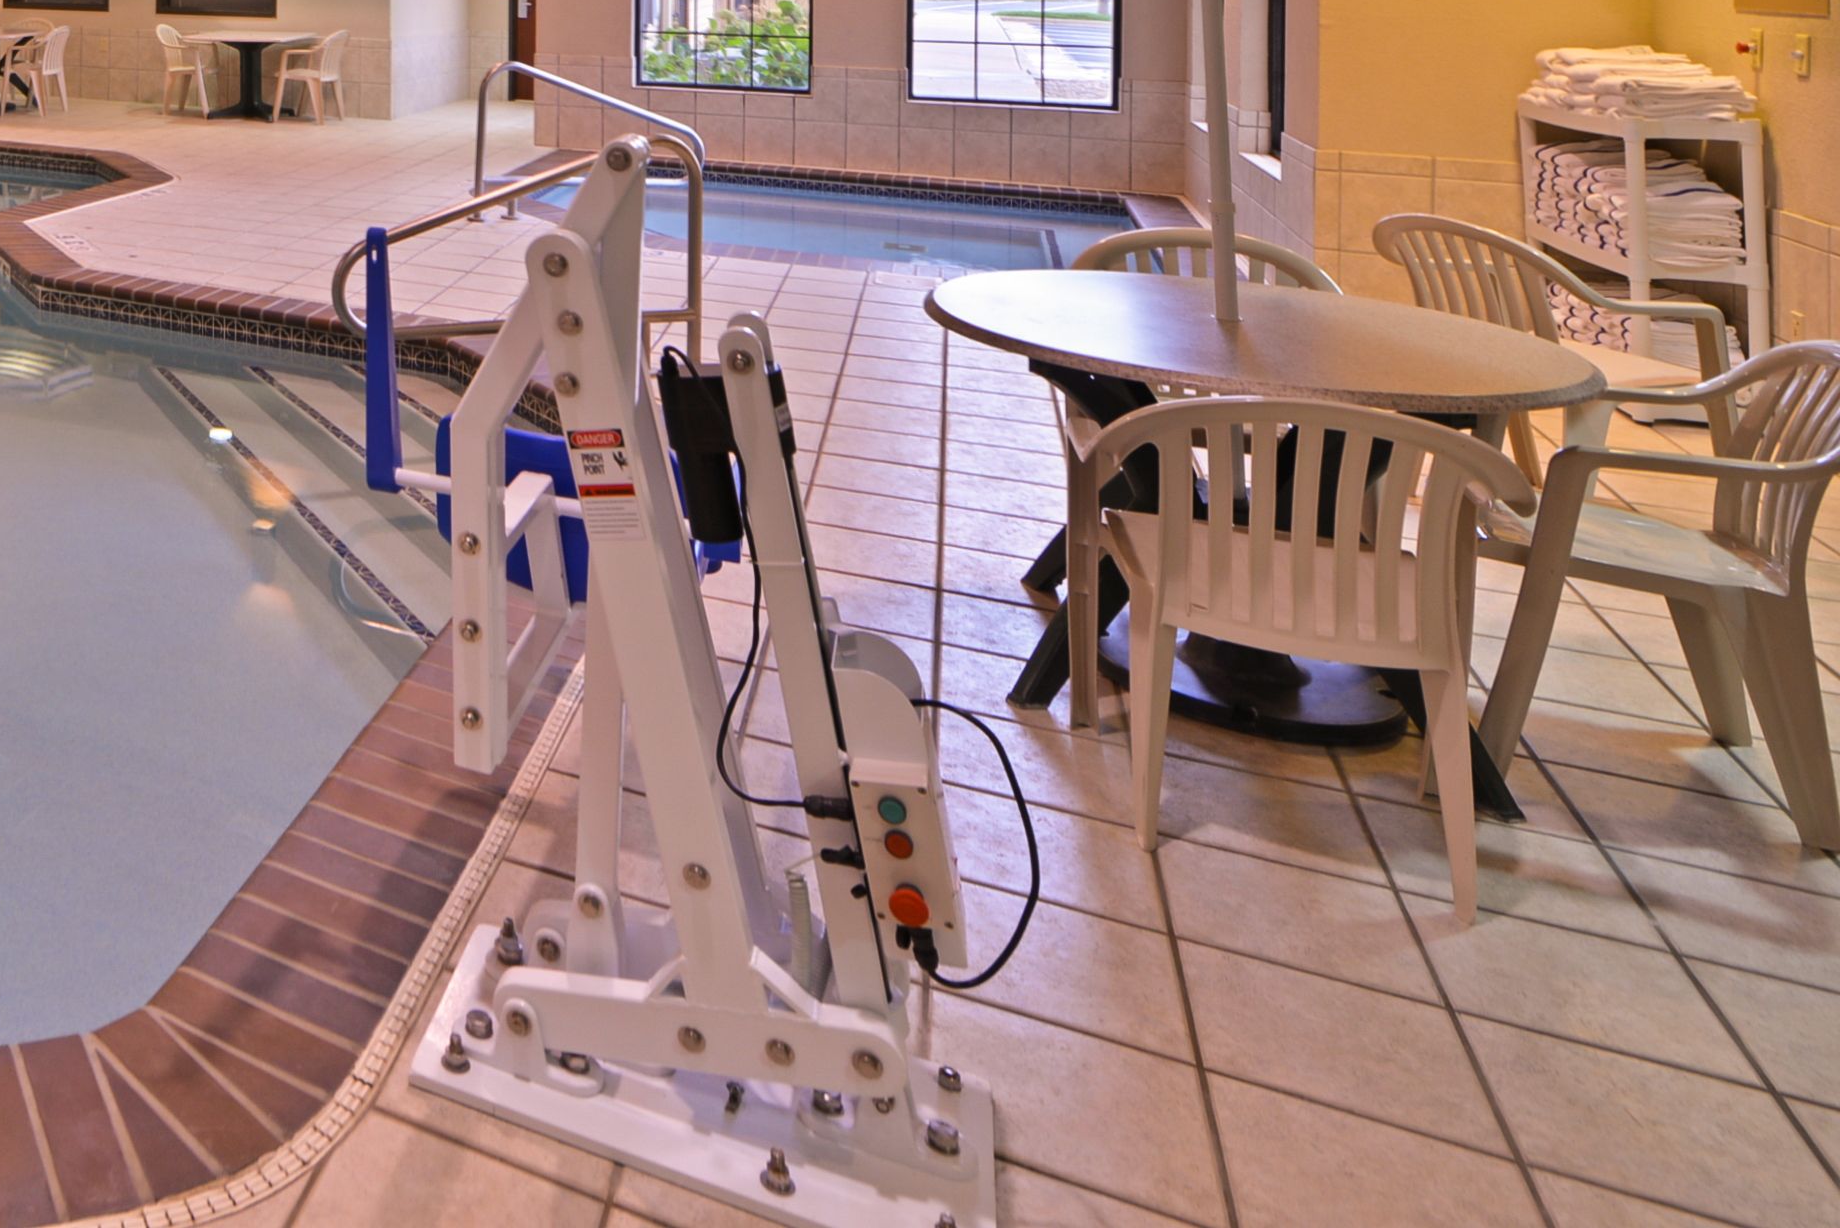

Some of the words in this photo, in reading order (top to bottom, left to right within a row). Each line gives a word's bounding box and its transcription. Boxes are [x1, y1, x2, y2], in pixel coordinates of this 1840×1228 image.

[576, 433, 616, 446] DANGER
[581, 453, 604, 464] PINCH
[583, 463, 606, 476] POINT
